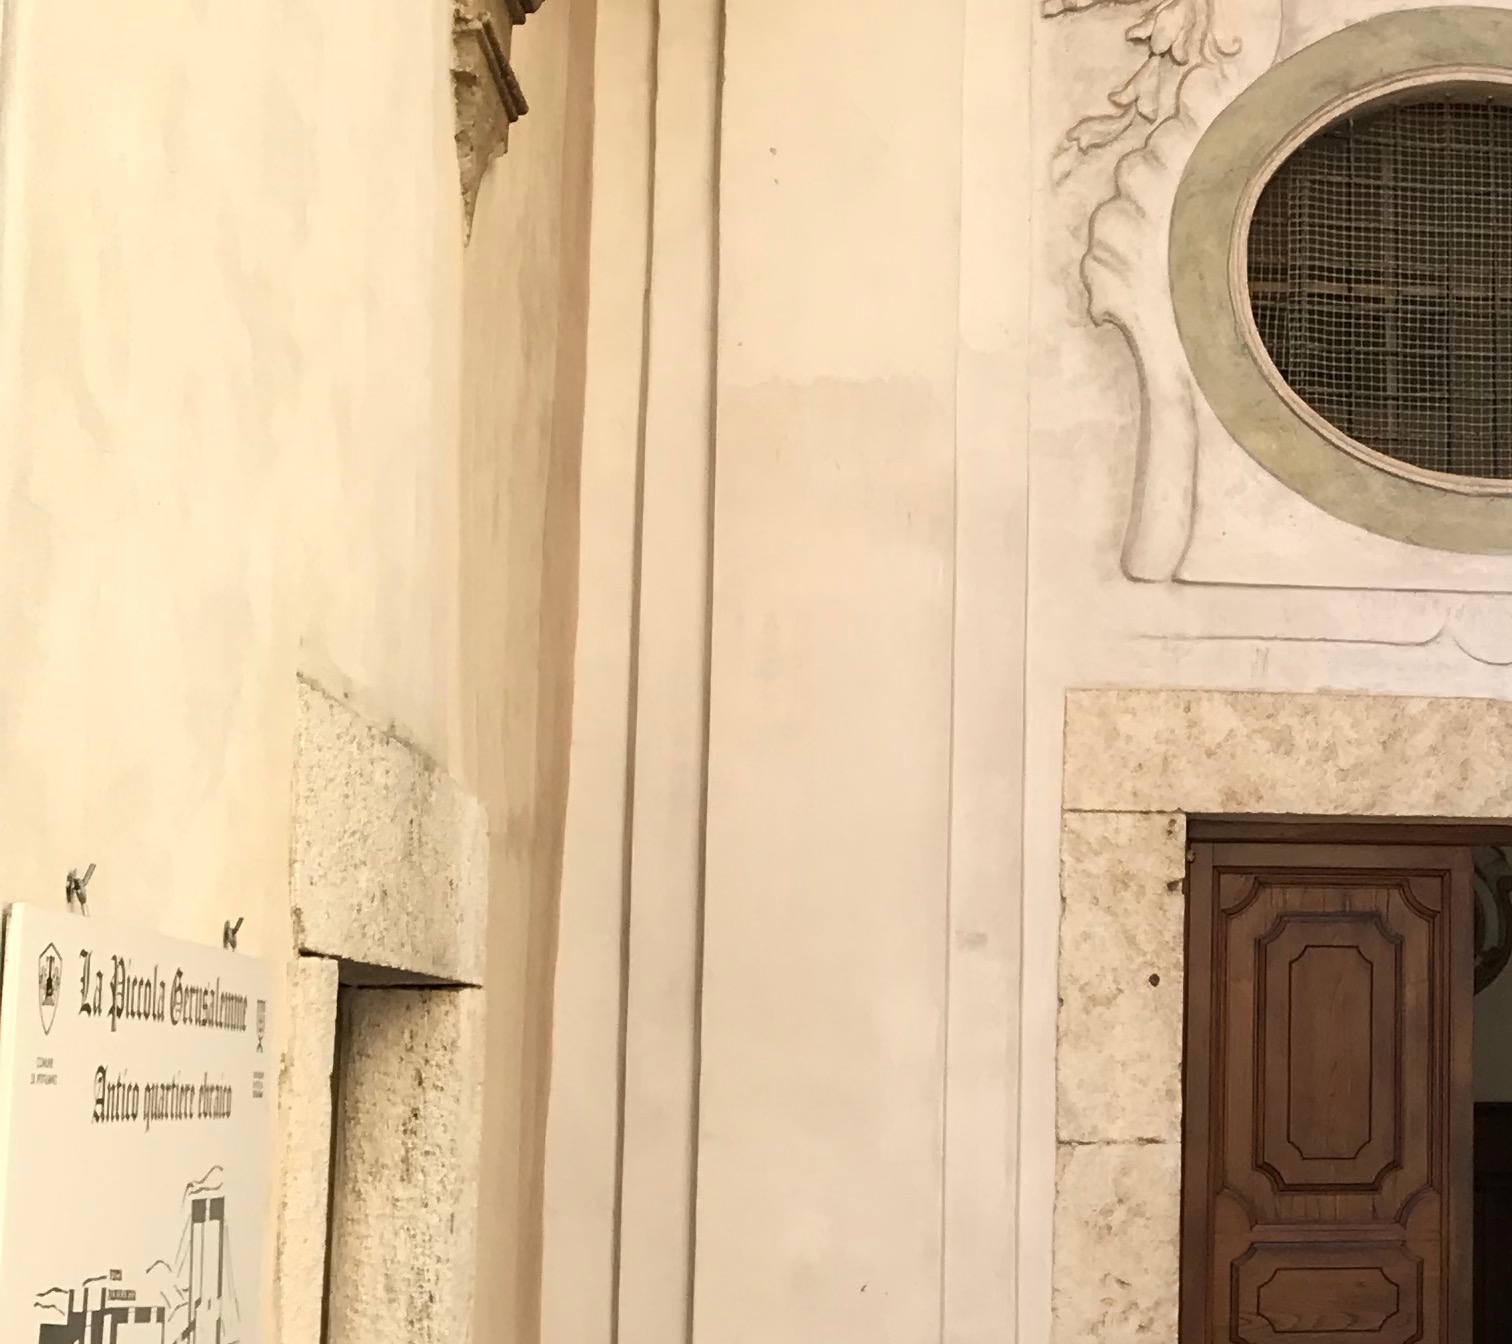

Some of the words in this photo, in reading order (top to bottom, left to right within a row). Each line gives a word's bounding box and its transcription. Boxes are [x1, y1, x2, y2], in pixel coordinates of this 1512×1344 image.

[78, 948, 103, 1018] La
[107, 954, 166, 1032] Piccola
[91, 1065, 140, 1124] Antico
